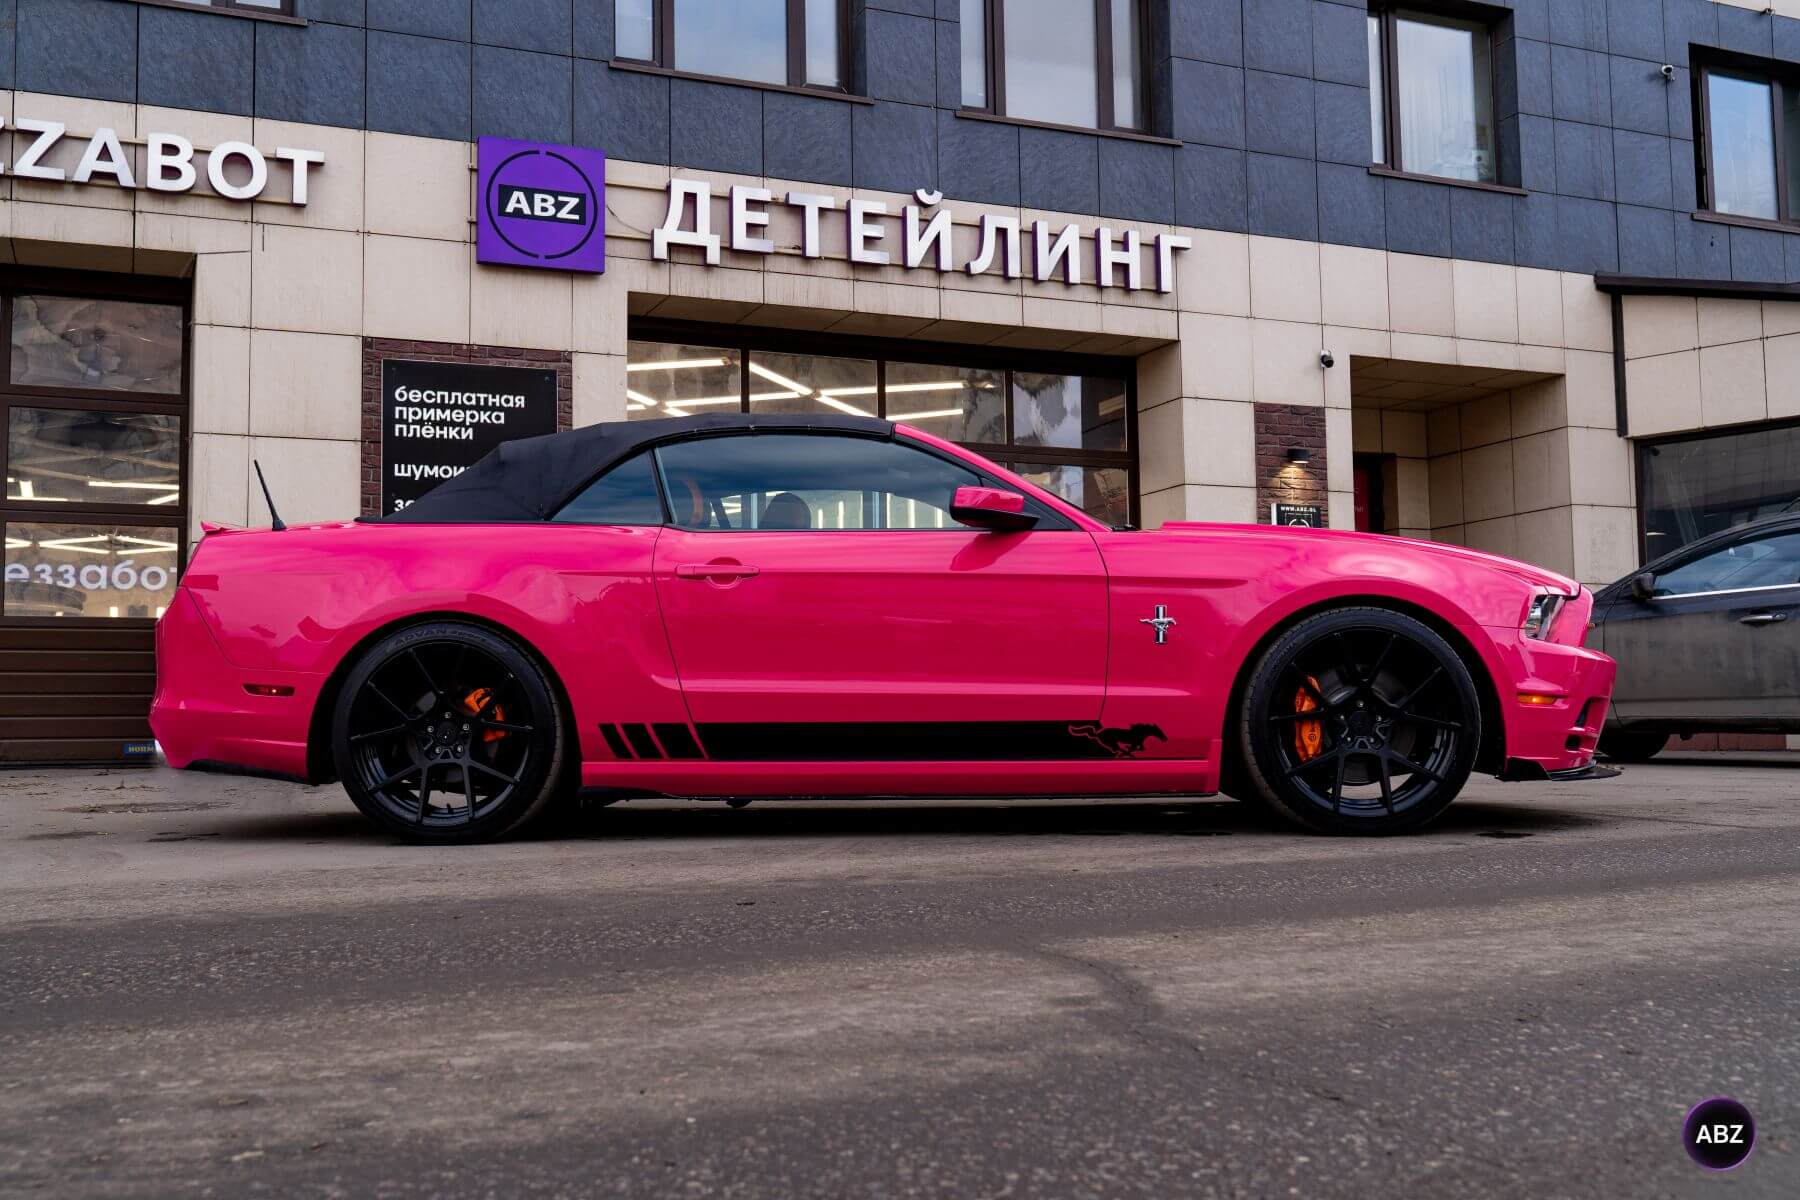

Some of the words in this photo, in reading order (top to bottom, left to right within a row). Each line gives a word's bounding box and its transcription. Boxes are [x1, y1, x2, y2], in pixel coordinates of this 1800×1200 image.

[0, 116, 325, 207] ZABOT
[505, 190, 580, 220] ABZ
[651, 178, 1192, 294] ДЕТЕЙЛИНГ
[394, 385, 526, 408] бесплатная
[394, 406, 505, 425] примерка
[394, 422, 474, 440] плёнки
[394, 463, 471, 480] шумои
